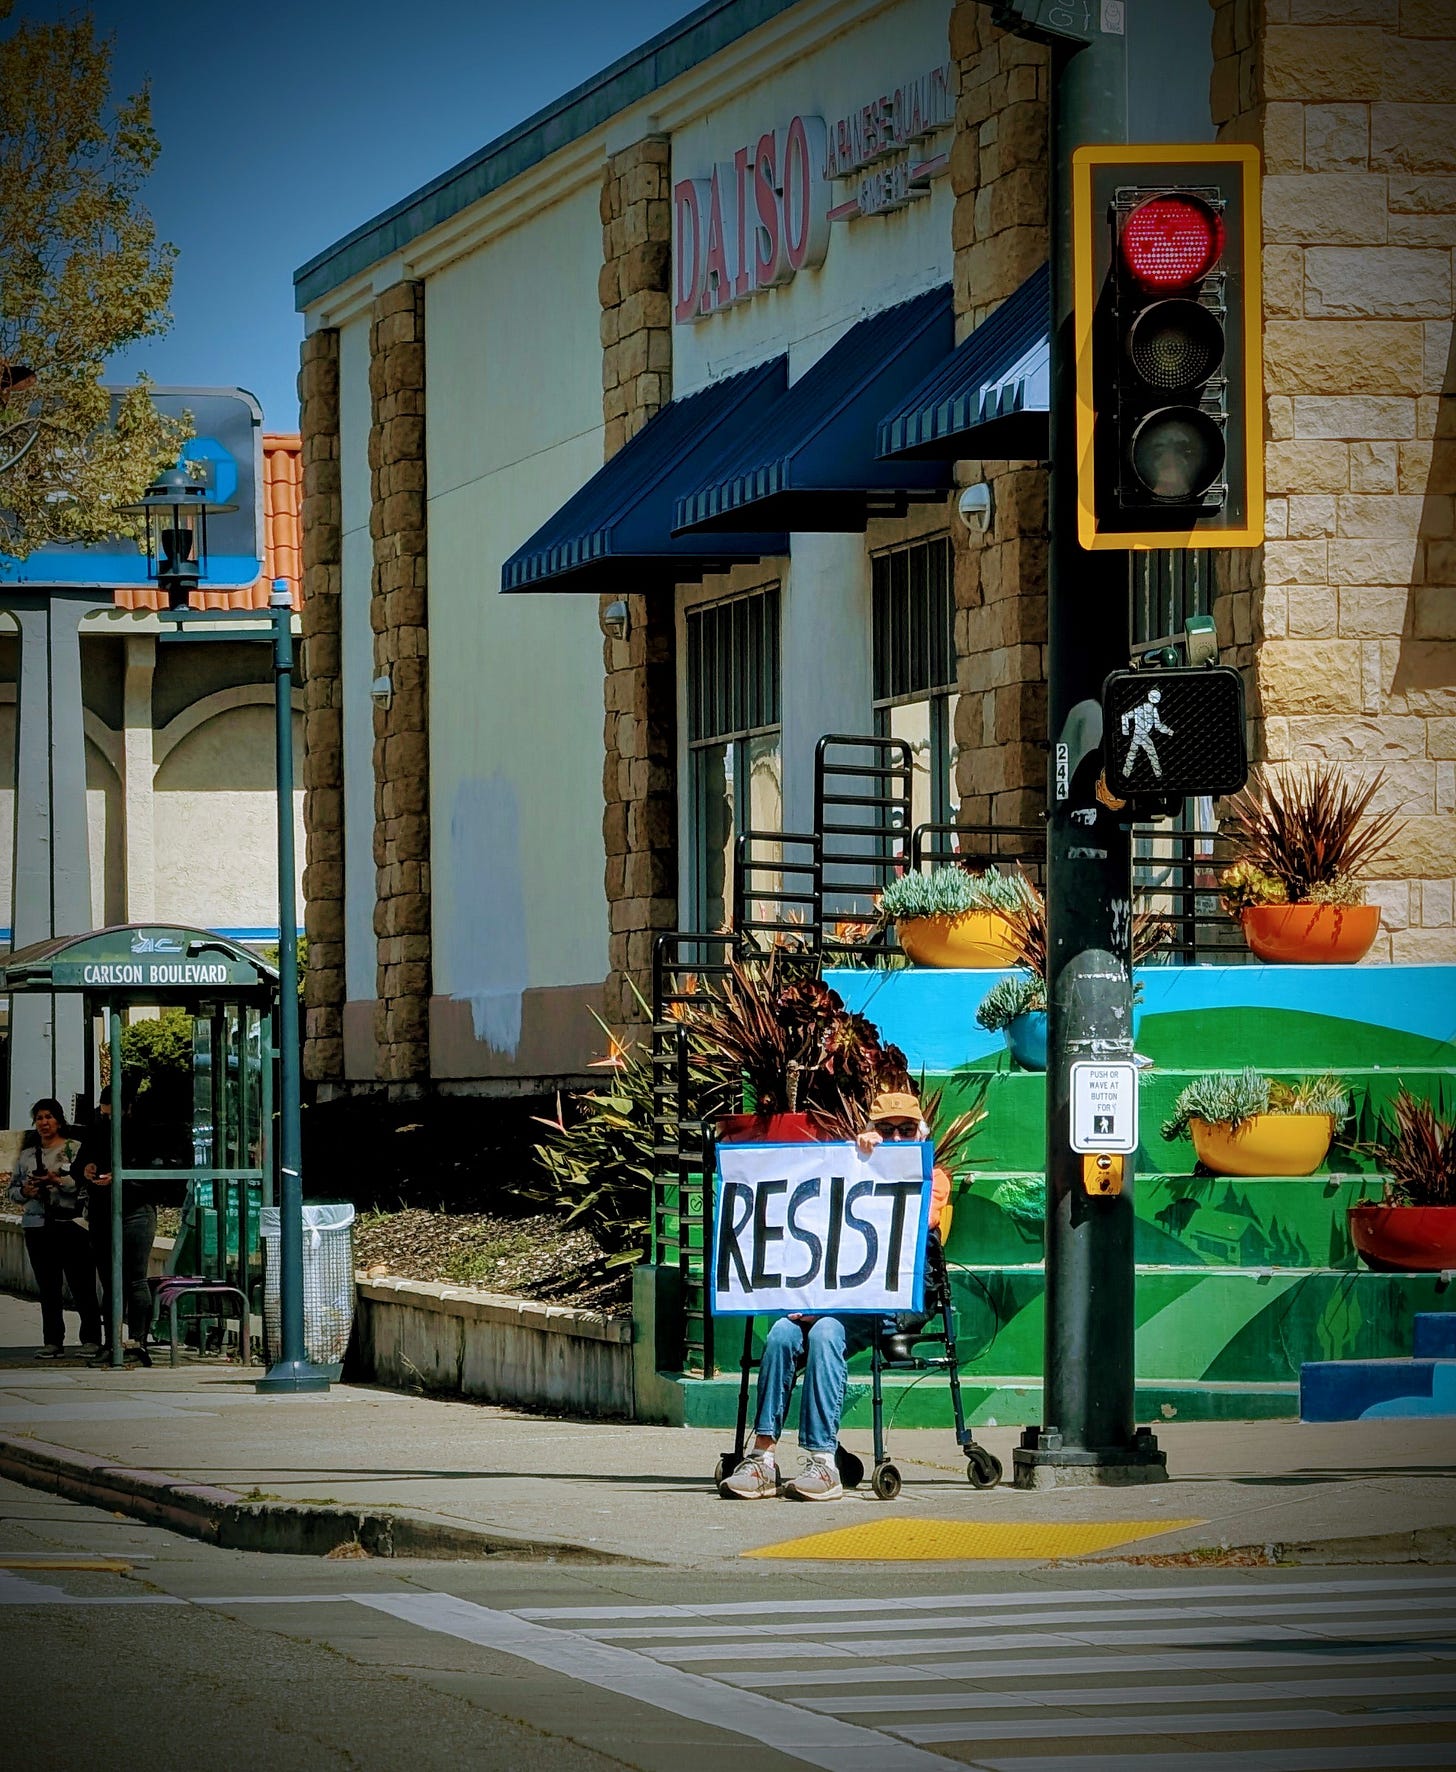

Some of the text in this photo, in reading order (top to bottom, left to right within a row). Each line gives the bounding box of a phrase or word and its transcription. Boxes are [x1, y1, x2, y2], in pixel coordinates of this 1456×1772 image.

[674, 116, 811, 325] DAISO
[1057, 745, 1067, 798] 244
[83, 965, 227, 983] CARLSON BOULEVARD
[1090, 1070, 1119, 1078] PUSH OR
[1089, 1081, 1119, 1089] WAVE AT
[1090, 1092, 1118, 1101] BUTTON
[1097, 1103, 1111, 1112] FOR
[716, 1176, 923, 1294] RESIST
